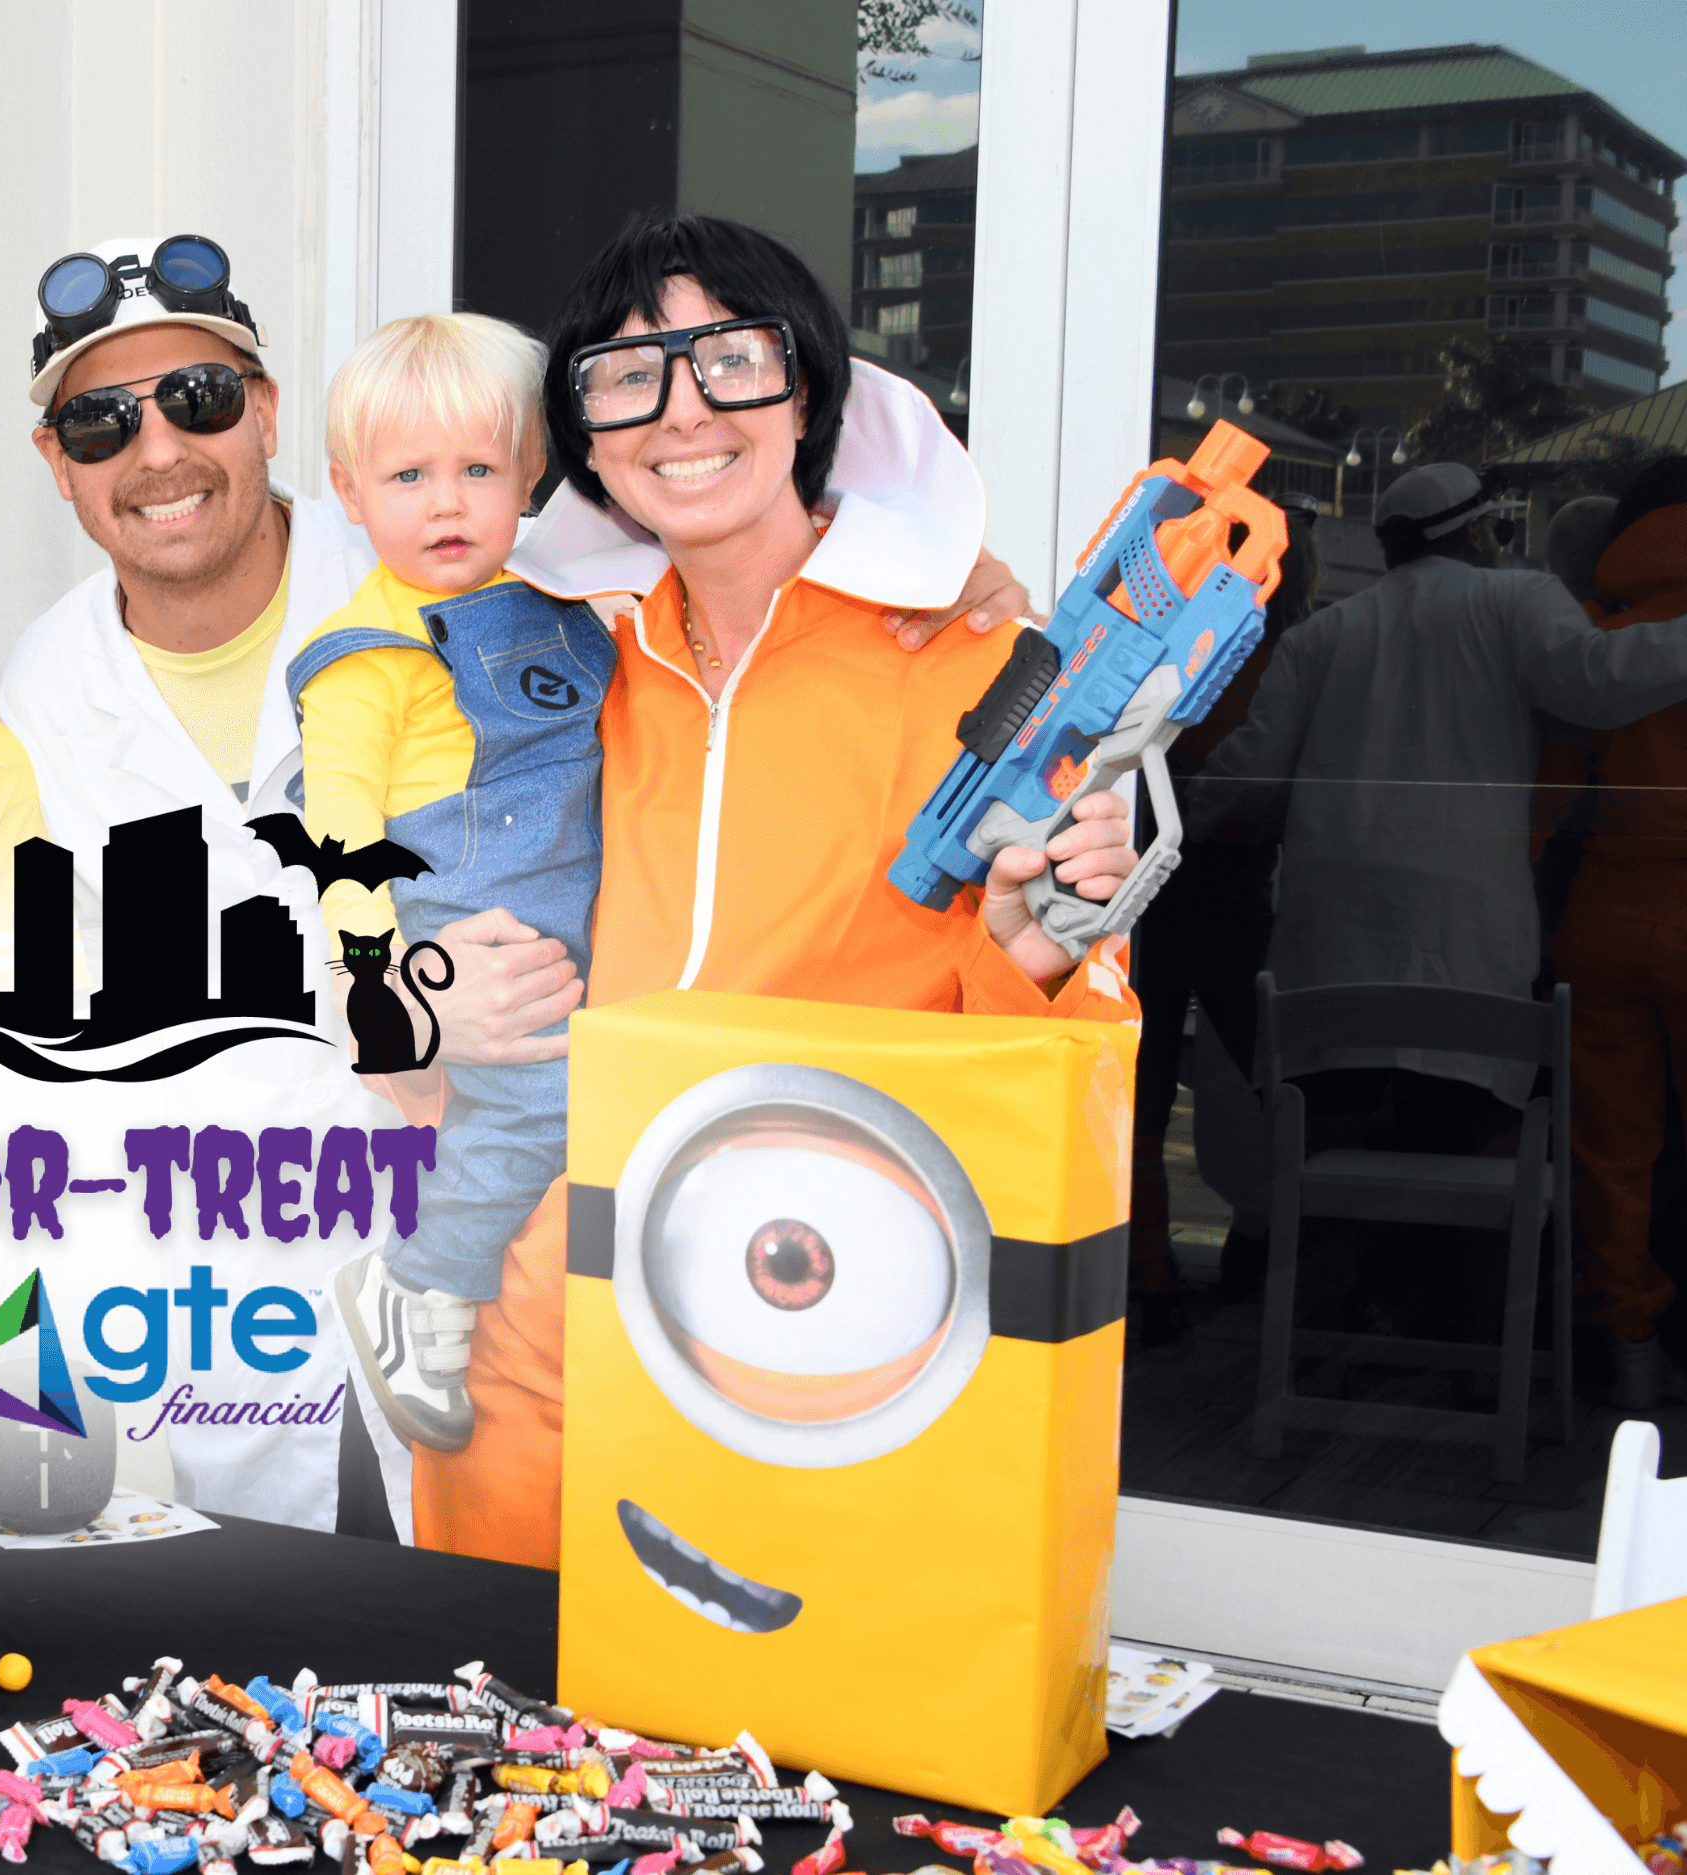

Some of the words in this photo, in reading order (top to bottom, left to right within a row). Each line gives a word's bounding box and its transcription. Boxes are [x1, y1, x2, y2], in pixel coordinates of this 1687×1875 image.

[1078, 485, 1147, 578] COMMANDER
[1015, 648, 1090, 749] ELITE
[36, 1719, 78, 1745] Roll
[674, 1788, 720, 1804] Roll
[722, 1788, 797, 1804] Tootsie
[693, 1800, 772, 1818] Tootsie
[773, 1801, 820, 1818] Roll
[689, 1828, 737, 1849] Roll
